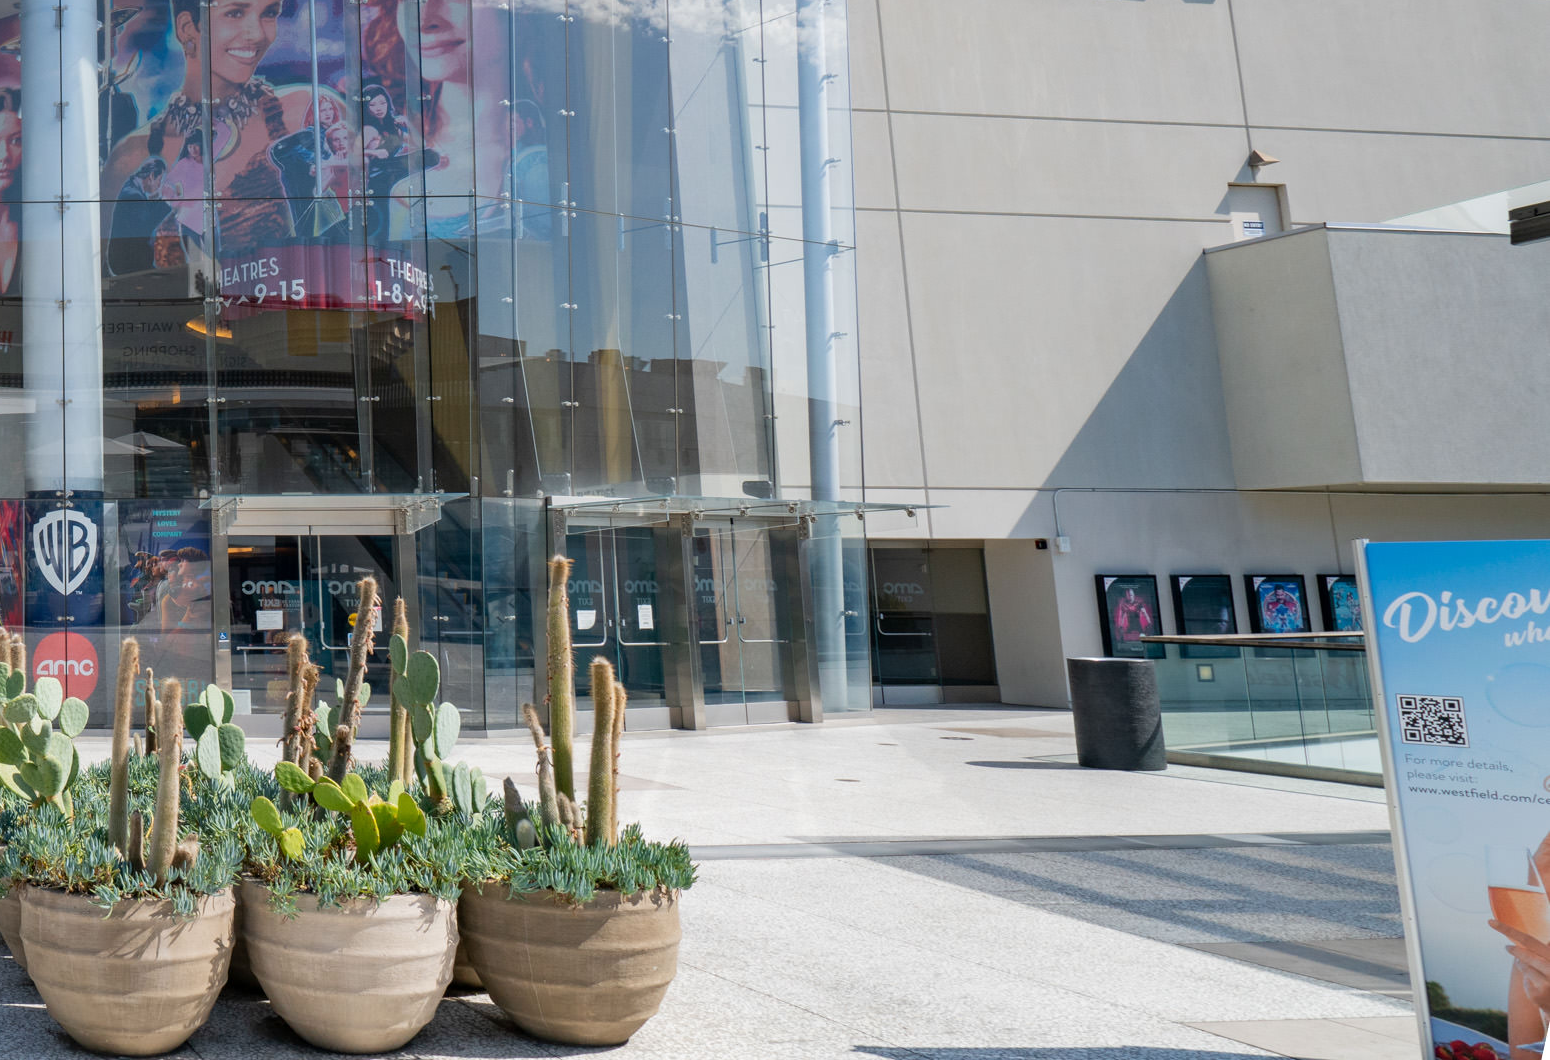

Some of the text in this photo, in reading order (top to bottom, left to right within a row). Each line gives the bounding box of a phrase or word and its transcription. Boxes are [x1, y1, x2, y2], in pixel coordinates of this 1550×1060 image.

[216, 257, 279, 288] HEATRES
[254, 279, 305, 304] 9-15
[376, 280, 402, 304] 1-8
[37, 659, 95, 677] amc
[1404, 753, 1426, 765] For
[1430, 758, 1464, 769] more
[1407, 769, 1445, 782] please
